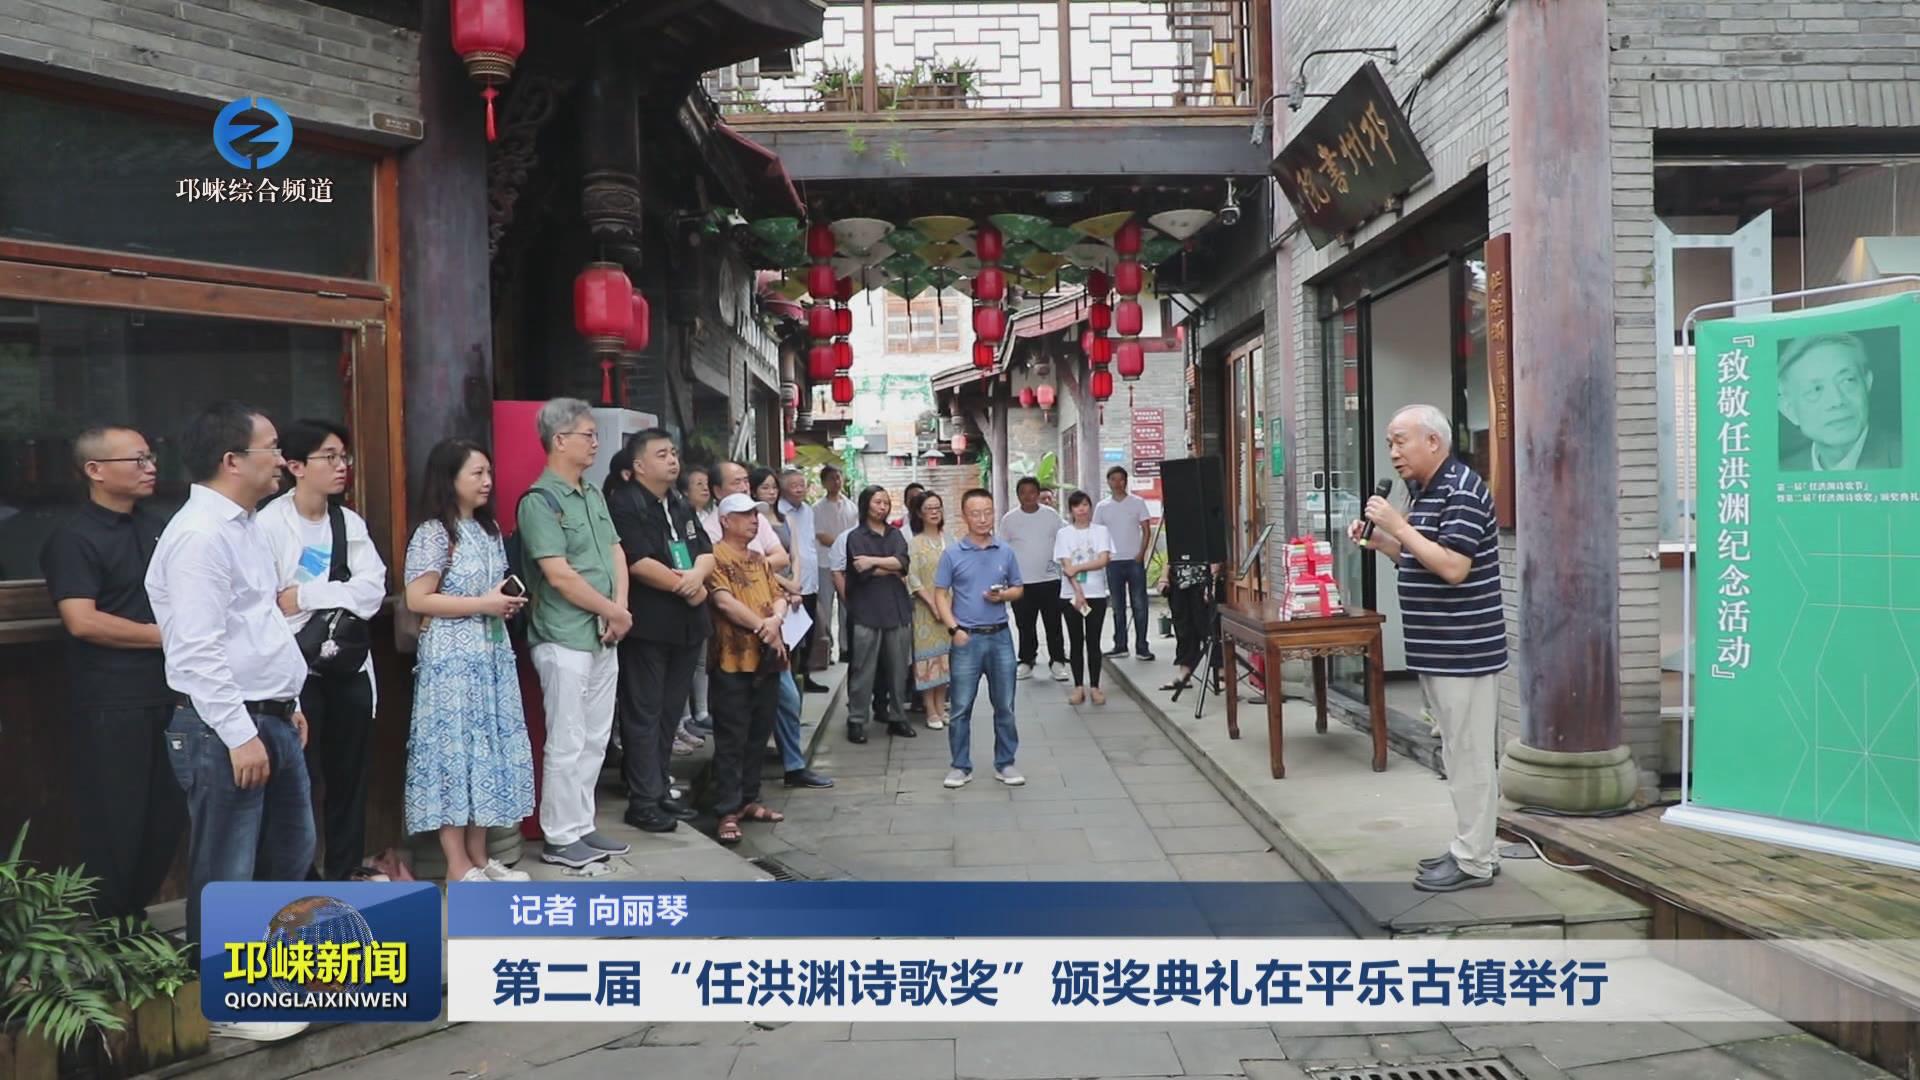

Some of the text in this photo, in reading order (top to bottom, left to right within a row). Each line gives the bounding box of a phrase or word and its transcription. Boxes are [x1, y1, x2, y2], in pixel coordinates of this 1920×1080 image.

[1712, 336, 1754, 678] 『致敬任洪渊纪念活动』
